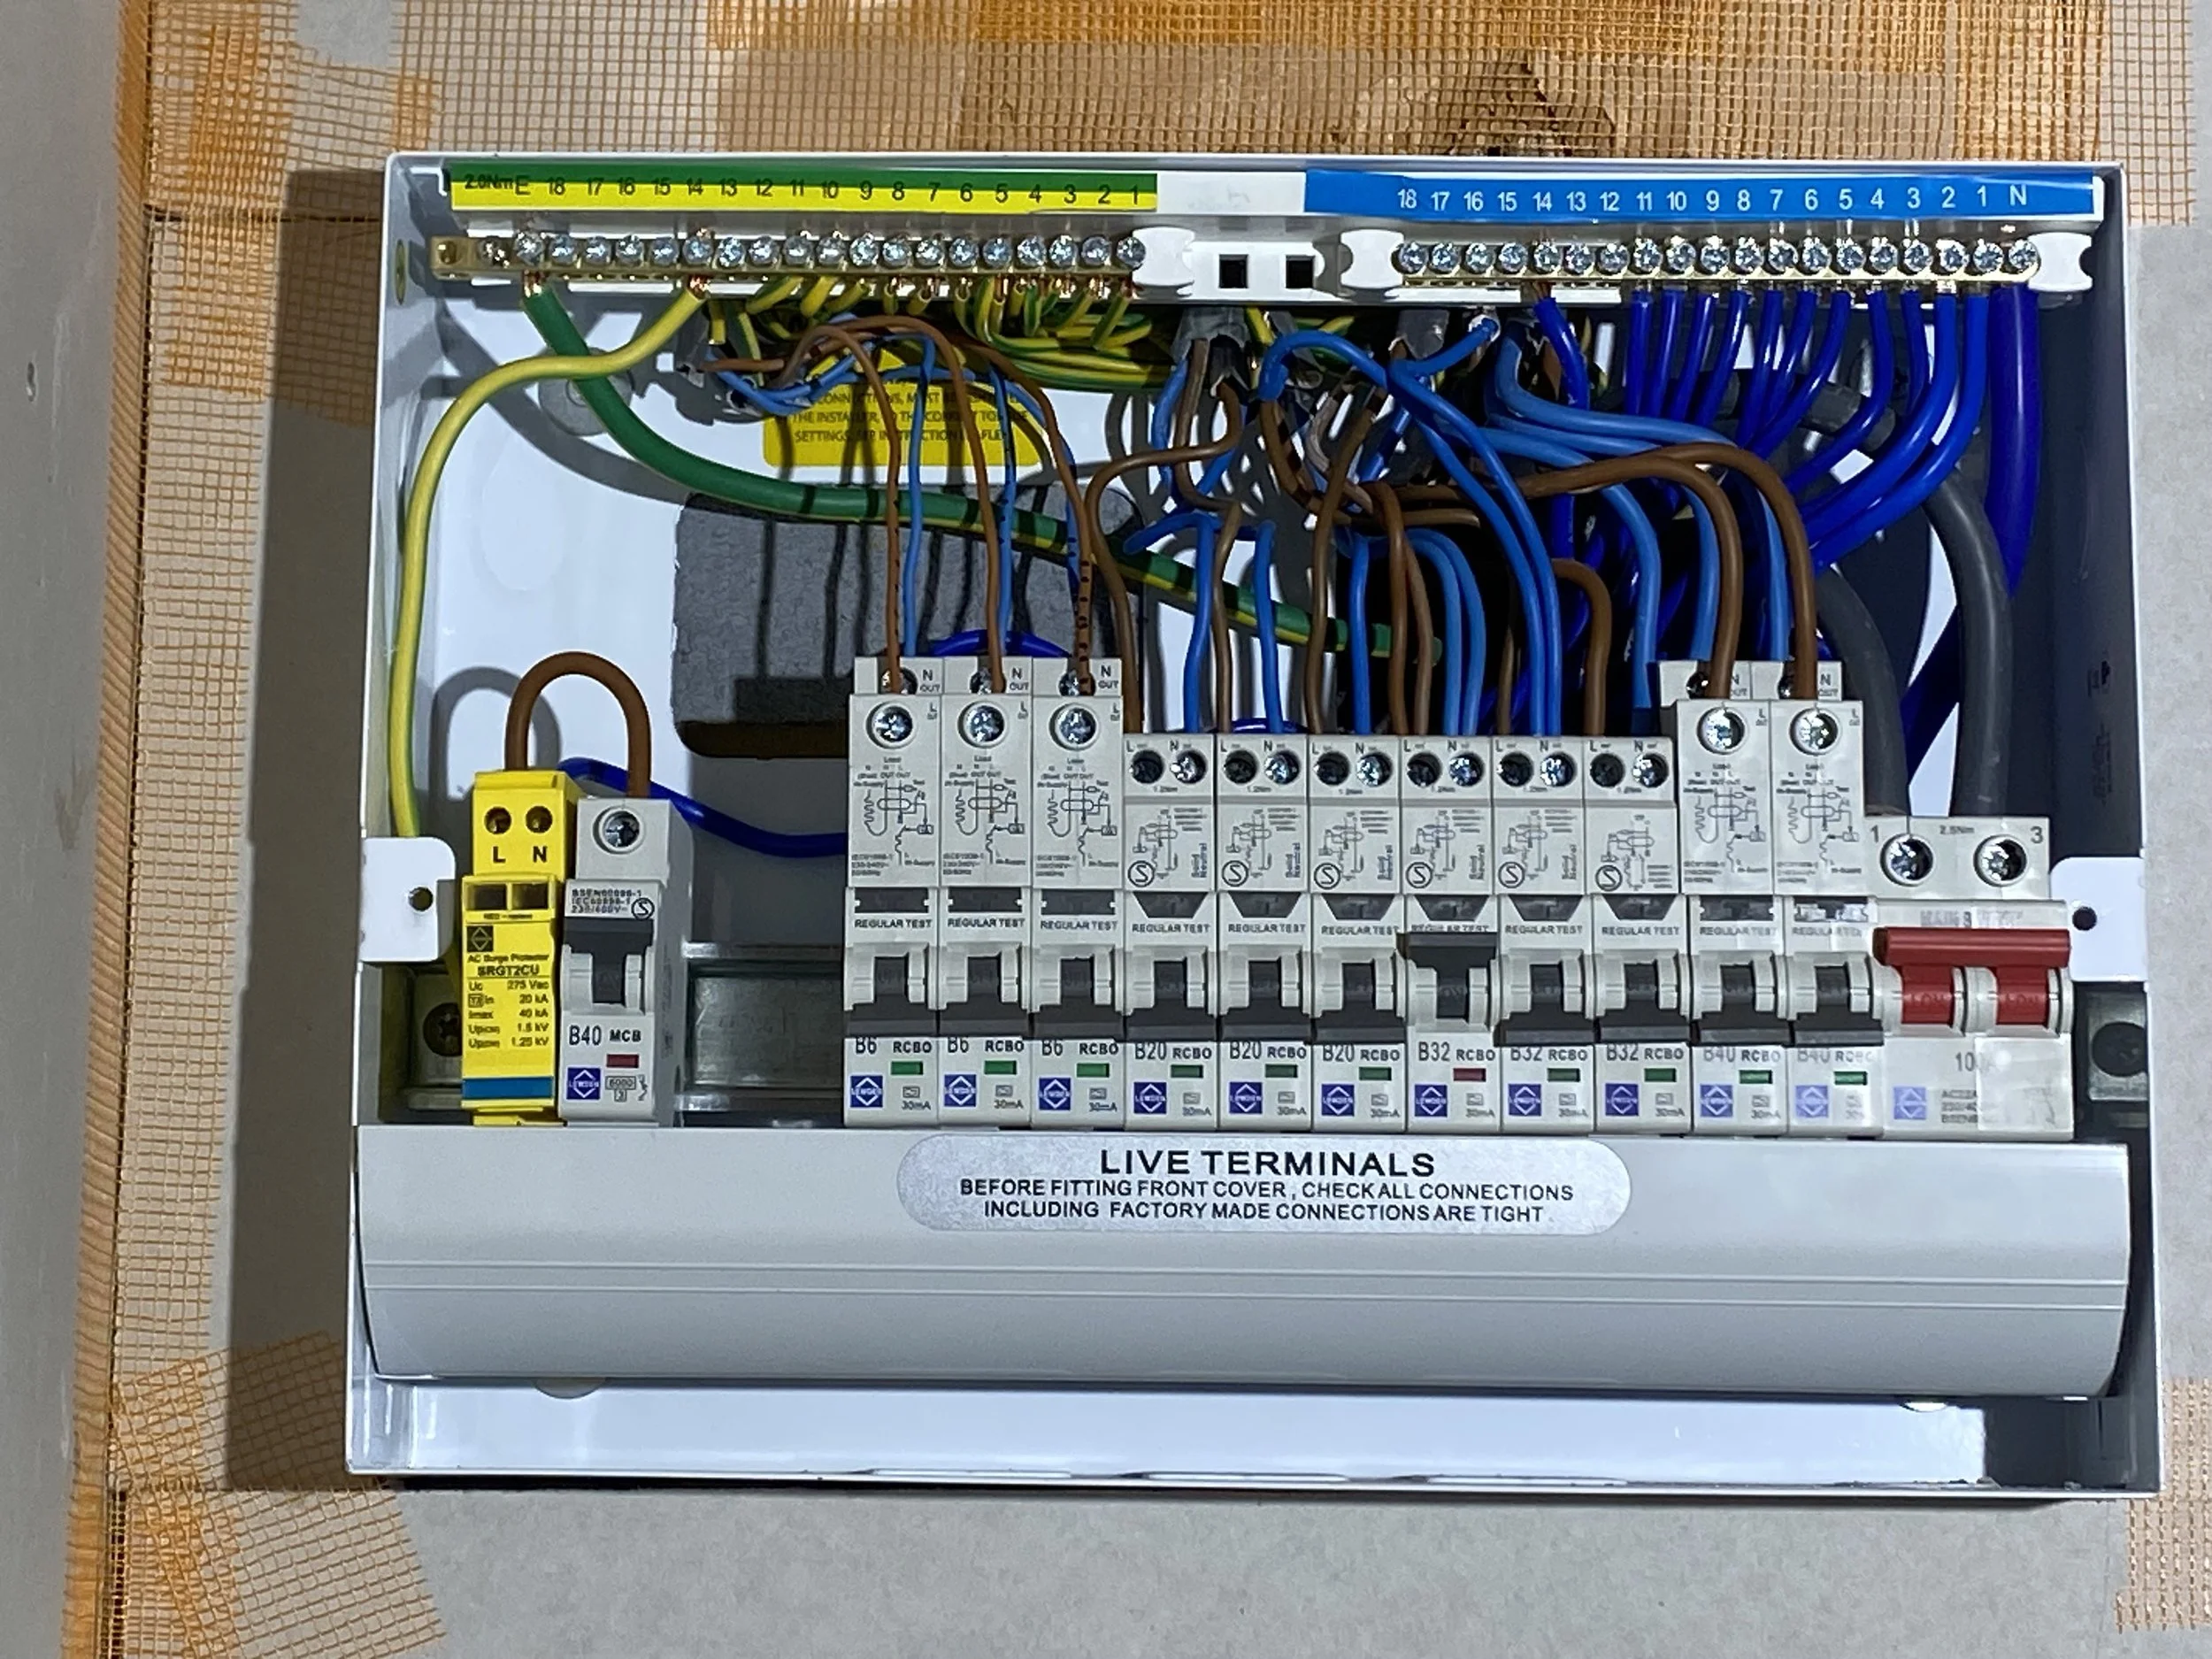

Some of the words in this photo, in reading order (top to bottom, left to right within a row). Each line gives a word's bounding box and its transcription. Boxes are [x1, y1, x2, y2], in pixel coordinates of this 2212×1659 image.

[515, 175, 530, 195] E
[548, 178, 565, 196] 18
[587, 178, 604, 196] 17
[618, 177, 635, 196] 16
[653, 177, 670, 196] 15
[687, 178, 703, 196] 14
[719, 178, 737, 196] 13
[756, 178, 772, 196] 12
[790, 179, 804, 196] 11
[822, 181, 839, 199] 10
[860, 181, 872, 200] 9
[892, 181, 905, 201] 8
[929, 182, 941, 202] 7
[960, 182, 973, 203] 6
[995, 183, 1008, 203] 5
[1029, 184, 1041, 203] 4
[1064, 184, 1077, 204] 3
[1098, 185, 1110, 204] 2
[1132, 185, 1139, 204] 1
[1398, 189, 1417, 209] 18
[1432, 192, 1450, 211] 17
[1464, 192, 1483, 211] 16
[1498, 192, 1517, 211] 15
[1533, 192, 1551, 211] 14
[1567, 191, 1586, 211] 13
[1601, 191, 1619, 211] 12
[1637, 192, 1653, 211] 11
[1667, 191, 1686, 211] 10
[1706, 190, 1719, 211] 9
[1737, 189, 1751, 211] 8
[1770, 189, 1784, 211] 7
[1804, 189, 1818, 211] 6
[1839, 188, 1853, 211] 5
[1870, 188, 1885, 210] 4
[1907, 187, 1921, 209] 3
[1941, 187, 1955, 208] 2
[1978, 186, 1985, 206] 1
[2010, 185, 2026, 206] N
[923, 670, 933, 680] N
[1011, 668, 1022, 679] N
[1101, 665, 1111, 677] N
[1820, 674, 1831, 685] N
[1170, 740, 1179, 751] N
[1263, 740, 1272, 751] N
[1356, 743, 1364, 754] N
[1447, 740, 1457, 751] N
[1540, 740, 1548, 751] N
[1634, 741, 1643, 751] N
[1870, 825, 1878, 843] 1
[2031, 826, 2043, 844] 3
[493, 847, 506, 863] L
[534, 847, 548, 863] N
[855, 919, 903, 928] REGULAR
[948, 918, 996, 927] REGULAR
[999, 918, 1025, 927] TEST
[1041, 920, 1090, 930] REGULAR
[1093, 921, 1118, 930] TEST
[1132, 923, 1182, 933] REGULAR
[1184, 924, 1210, 933] TEST
[1228, 923, 1278, 933] REGULAR
[1280, 924, 1306, 933] TEST
[1321, 926, 1371, 935] REGULAR
[1373, 926, 1400, 935] TEST
[1505, 925, 1555, 934] REGULAR
[1557, 926, 1583, 934] TEST
[1601, 926, 1652, 935] REGULAR
[1654, 926, 1679, 936] TEST
[519, 994, 532, 1003] 20
[519, 1009, 532, 1018] 40
[569, 1025, 601, 1046] B40
[610, 1029, 641, 1042] MCB
[856, 1037, 877, 1054] B6
[893, 1041, 932, 1053] RCBO
[948, 1036, 969, 1053] B6
[985, 1040, 1025, 1052] RCBO
[1079, 1042, 1118, 1055] RCBO
[1230, 1041, 1262, 1059] B20
[1267, 1046, 1307, 1059] RCBO
[1135, 1042, 1167, 1060] B20
[1172, 1048, 1212, 1059] RCBO
[1323, 1044, 1355, 1062] B20
[1360, 1049, 1400, 1061] RCBO
[1418, 1041, 1450, 1061] B32
[1456, 1049, 1496, 1061] RCBO
[1548, 1049, 1588, 1061] RCBO
[1607, 1043, 1639, 1061] B32
[1644, 1048, 1684, 1060] RCBO
[1741, 1050, 1781, 1062] RCBO
[1101, 1150, 1190, 1174] LIVE
[1201, 1150, 1434, 1176] TERMINALS
[961, 1179, 1045, 1196] BEFORE
[1051, 1180, 1132, 1196] FITTING
[1138, 1180, 1208, 1197] FRONT
[1302, 1182, 1375, 1199] CHECK
[1379, 1183, 1415, 1199] ALL
[1419, 1183, 1573, 1201] CONNECTIONS
[985, 1202, 1099, 1217] INCLUDING
[1110, 1202, 1206, 1218] FACTORY
[1212, 1203, 1270, 1218] MADE
[1277, 1203, 1430, 1221] CONNECTIONS
[1433, 1205, 1475, 1221] ARE
[1484, 1206, 1544, 1222] TIGHT
